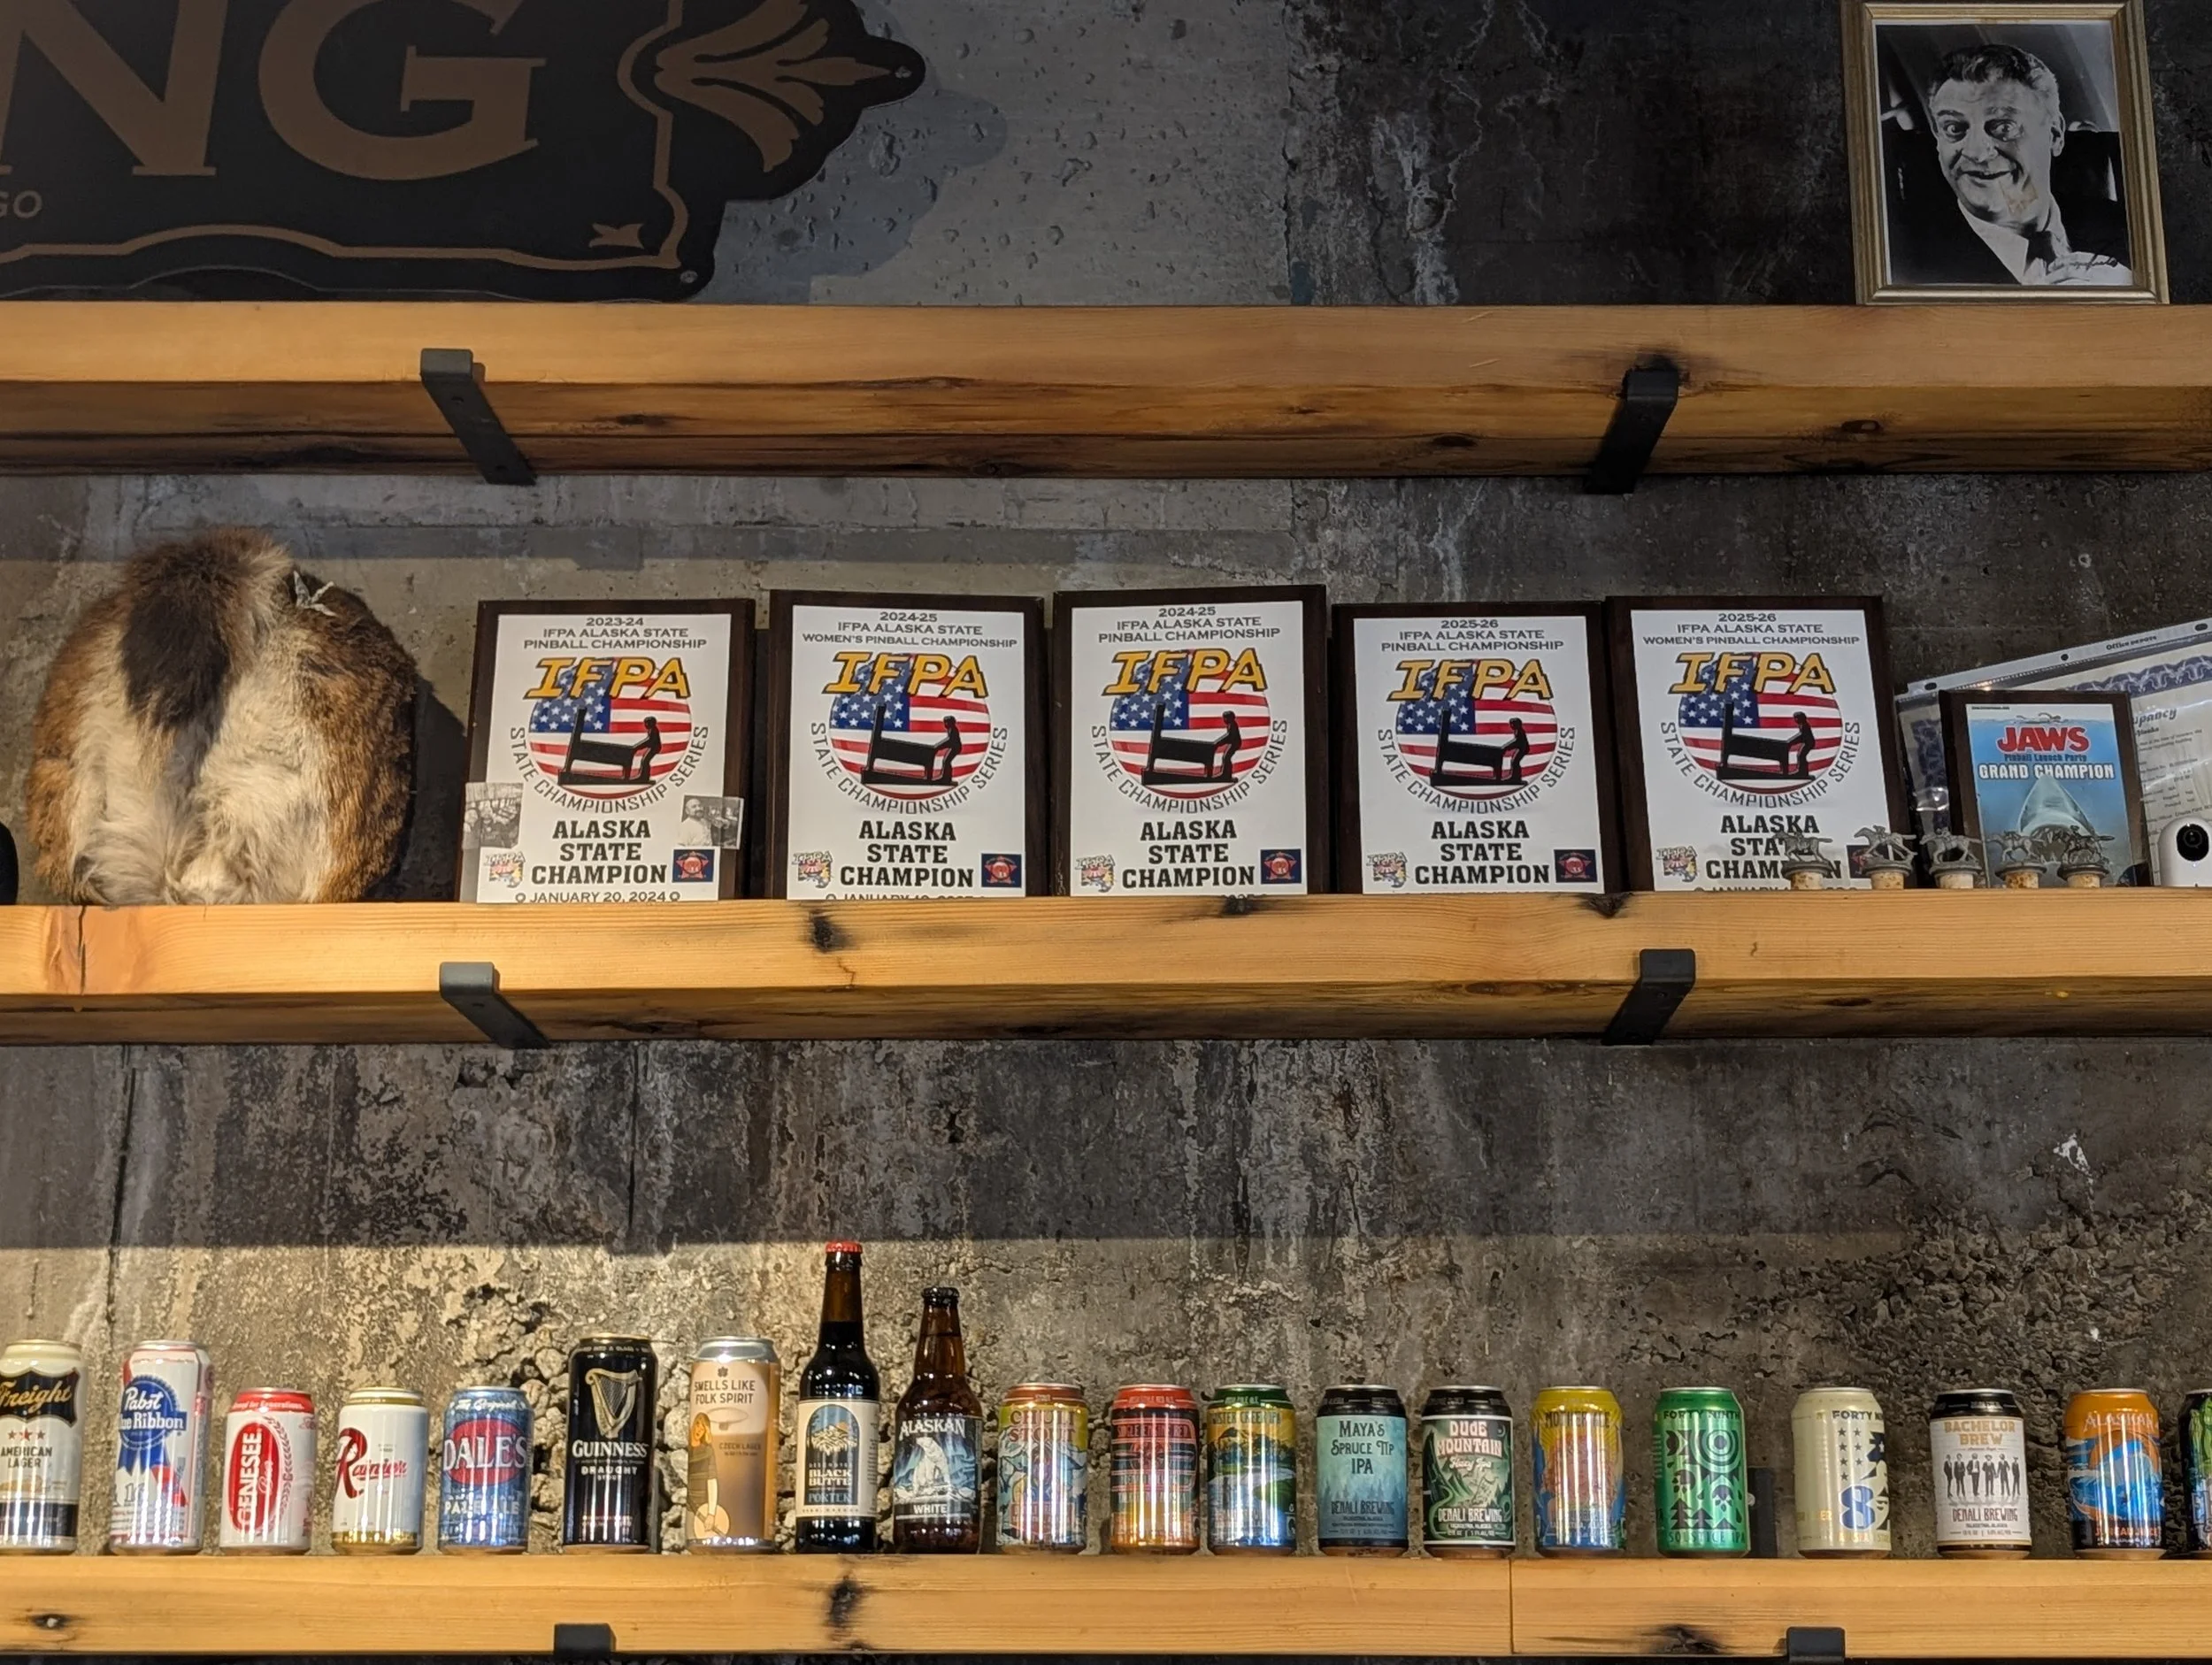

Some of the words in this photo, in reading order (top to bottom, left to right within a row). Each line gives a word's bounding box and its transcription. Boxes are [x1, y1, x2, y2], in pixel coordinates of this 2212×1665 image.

[879, 611, 937, 622] 2024-25
[1159, 608, 1216, 618] 2024-25
[1718, 613, 1776, 622] 2025-26
[586, 618, 643, 626] 2023-24
[838, 623, 870, 632] IFPA
[874, 624, 933, 633] ALASKA
[938, 625, 982, 635] STATE
[1118, 620, 1149, 630] IFPA
[1153, 618, 1212, 629] ALASKA
[1217, 617, 1261, 627] STATE
[1441, 620, 1498, 629] 2025-26
[1678, 624, 1710, 633] IFPA
[1714, 624, 1774, 633] ALASKA
[1778, 624, 1823, 633] STATE
[543, 629, 574, 638] IFPA
[581, 629, 639, 638] ALASKA
[644, 628, 688, 637] STATE
[803, 634, 863, 644] WOMEN'S
[865, 636, 918, 646] PINBALL
[922, 637, 1017, 648] CHAMPIONSHIP
[1099, 633, 1162, 643] PINBALL
[1172, 628, 1280, 641] CHAMPIONSHIP
[1400, 632, 1431, 641] IFPA
[1436, 631, 1495, 640] ALASKA
[1500, 630, 1544, 639] STATE
[524, 640, 588, 648] PINBALL
[592, 640, 707, 648] CHAMPIONSHIP
[1382, 642, 1445, 651] PINBALL
[1448, 641, 1563, 650] CHAMPIONSHIP
[2106, 641, 2129, 650] Office
[523, 656, 691, 700] IFPA
[822, 651, 988, 698] IFPA
[1102, 648, 1268, 696] IFPA
[1668, 652, 1837, 694] IFPA
[1386, 659, 1553, 702] IFPA
[1997, 726, 2090, 752] JAWS
[511, 726, 538, 783] STATE
[534, 779, 668, 814] CHAMPIONSHIP
[672, 726, 708, 786] SERIES
[811, 722, 841, 780] STATE
[838, 778, 971, 815] CHAMPIONSHIP
[975, 726, 1008, 789] SERIES
[1092, 725, 1122, 783] STATE
[1118, 779, 1251, 814] CHAMPIONSHIP
[1251, 720, 1287, 784] SERIES
[1379, 729, 1410, 784] STATE
[1407, 780, 1540, 815] CHAMPIONSHIP
[1541, 726, 1574, 787] SERIES
[1661, 721, 1689, 778] STATE
[1694, 774, 1827, 809] CHAMPIONSHIP
[1829, 722, 1860, 783] SERIES
[1979, 764, 2029, 779] GRAND
[2034, 763, 2114, 779] CHAMPION
[552, 820, 650, 839] ALASKA
[859, 820, 956, 840] ALASKA
[1141, 819, 1237, 840] ALASKA
[1432, 820, 1529, 839] ALASKA
[1721, 815, 1819, 833] ALASKA
[559, 843, 641, 862] STATE
[867, 845, 948, 863] STATE
[1148, 844, 1228, 863] STATE
[1440, 843, 1522, 862] STATE
[532, 865, 667, 884] CHAMPION
[841, 868, 973, 887] CHAMPION
[1123, 866, 1255, 888] CHAMPION
[1416, 865, 1549, 884] CHAMPION
[1706, 860, 1841, 879] CHAMN
[529, 892, 600, 903] JANUARY
[604, 892, 622, 902] 20,
[629, 892, 665, 902] 2024
[695, 1380, 728, 1392] SMELLS
[731, 1380, 756, 1391] LIKE
[125, 1386, 164, 1410] Pabst
[695, 1393, 717, 1405] FOLK
[719, 1393, 753, 1404] SPIRIT
[134, 1413, 184, 1430] Ribbon
[1663, 1410, 1703, 1419] FORTY
[1832, 1410, 1871, 1420] FORTY
[2084, 1412, 2154, 1431] ALASKAN
[899, 1419, 965, 1440] ALASKAN
[1944, 1421, 2016, 1433] BACHELOR
[1960, 1433, 2003, 1446] BREW
[1, 1446, 52, 1457] AMERICAN
[443, 1435, 526, 1471] DALE'S
[572, 1439, 649, 1457] GUINNESS
[1437, 1438, 1502, 1458] MOUNTAIN
[8, 1458, 41, 1469] LAGER
[581, 1466, 637, 1475] DRAUGHT
[1352, 1458, 1373, 1474] IPA
[809, 1477, 852, 1486] BUTTE
[809, 1493, 852, 1503] PORTER
[913, 1505, 947, 1514] WHITE
[1332, 1500, 1357, 1515] DENALI
[1438, 1508, 1466, 1523] DENALI
[1468, 1508, 1502, 1523] BREWING
[1953, 1508, 1983, 1522] DENALI
[1985, 1508, 2017, 1522] BREWING
